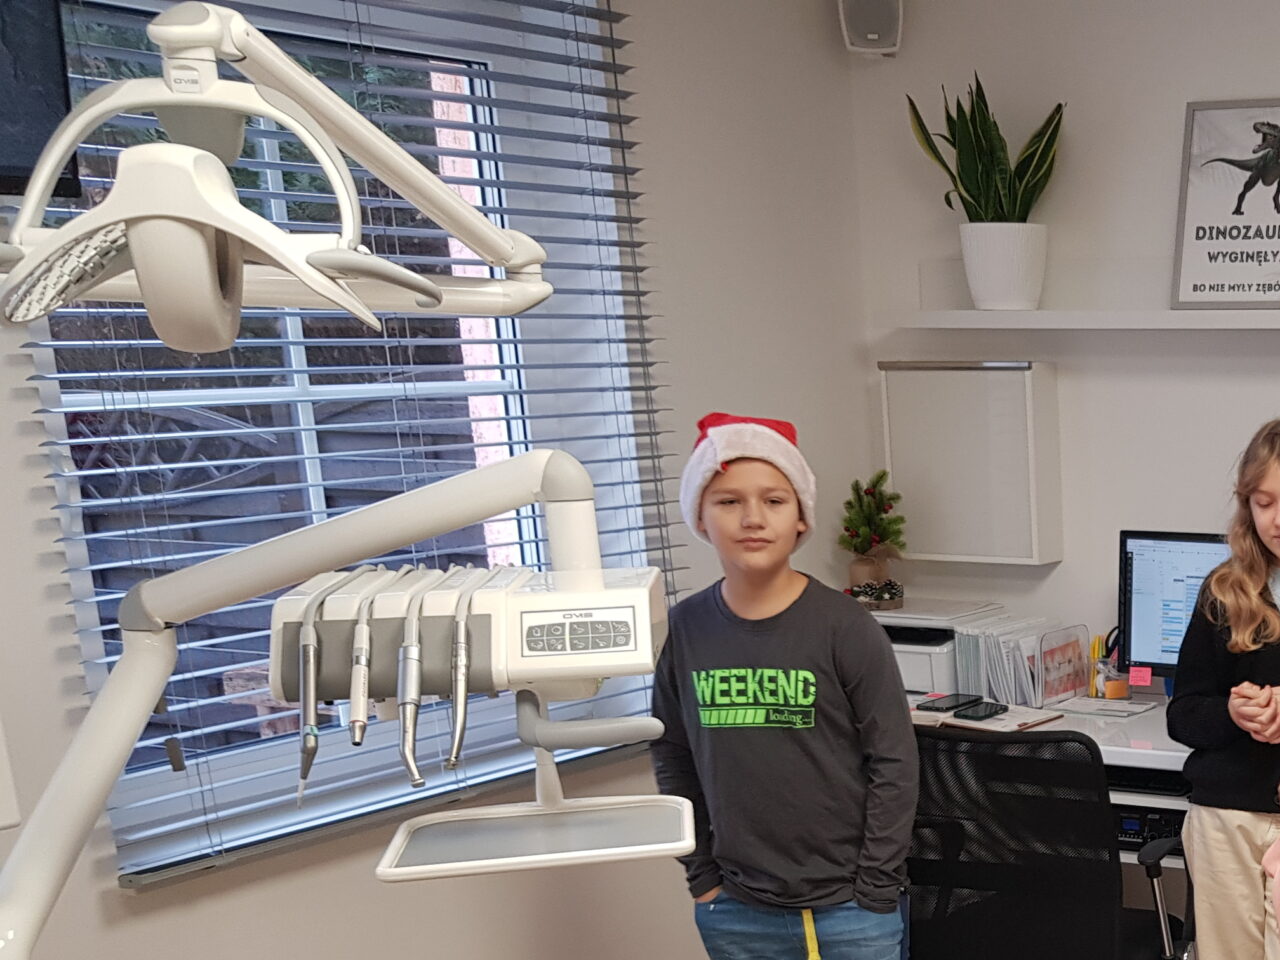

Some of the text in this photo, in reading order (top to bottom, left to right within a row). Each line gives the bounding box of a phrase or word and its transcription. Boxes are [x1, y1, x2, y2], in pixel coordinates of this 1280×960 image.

[1192, 283, 1207, 292] BO
[1208, 283, 1226, 292] NIE
[1228, 283, 1254, 292] MYŁY
[692, 668, 817, 706] WEEKEND
